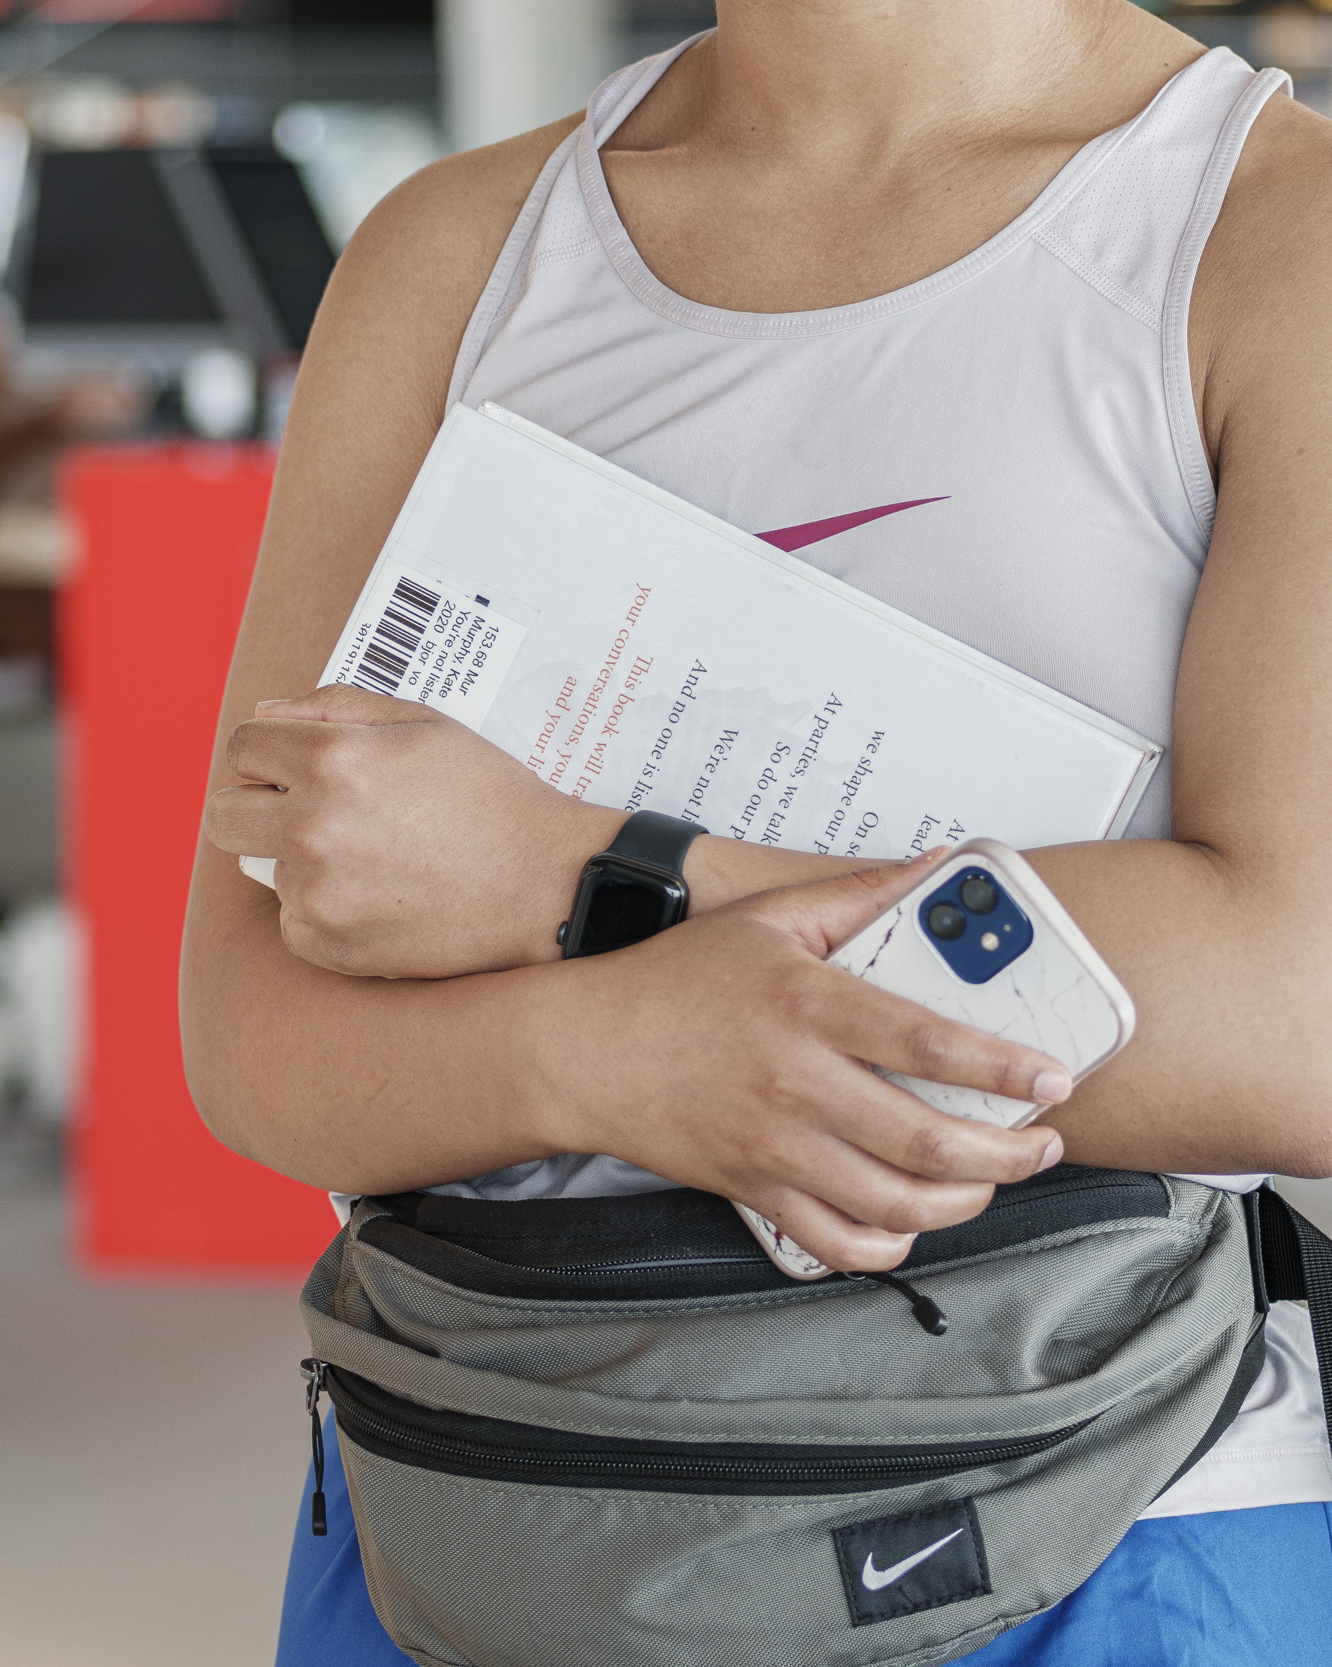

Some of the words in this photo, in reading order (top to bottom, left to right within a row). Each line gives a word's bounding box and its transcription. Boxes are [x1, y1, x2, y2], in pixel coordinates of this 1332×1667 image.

[432, 599, 456, 634] 2020
[625, 582, 651, 627] your
[443, 610, 472, 648] You're
[451, 614, 486, 664] Murphy,
[431, 649, 448, 672] not
[471, 625, 499, 668] 153.68
[407, 670, 421, 686] vo
[437, 667, 461, 698] Kate
[458, 668, 479, 696] Mur
[563, 628, 629, 746] conversations,
[624, 655, 653, 690] This
[679, 657, 708, 700] And
[554, 675, 577, 711] and
[822, 691, 843, 715] At
[600, 692, 635, 737] book
[667, 699, 686, 724] no
[534, 709, 561, 753] your
[650, 727, 673, 760] one
[789, 713, 829, 778] parties,
[865, 730, 885, 754] we
[583, 741, 607, 775] will
[769, 740, 791, 764] So
[641, 761, 660, 778] is
[756, 766, 778, 790] do
[840, 755, 873, 806] shape
[570, 775, 592, 800] tra
[687, 774, 710, 807] not
[777, 785, 798, 809] we
[740, 793, 761, 826] our
[824, 808, 845, 841] our
[854, 811, 879, 838] On
[945, 818, 966, 842] At
